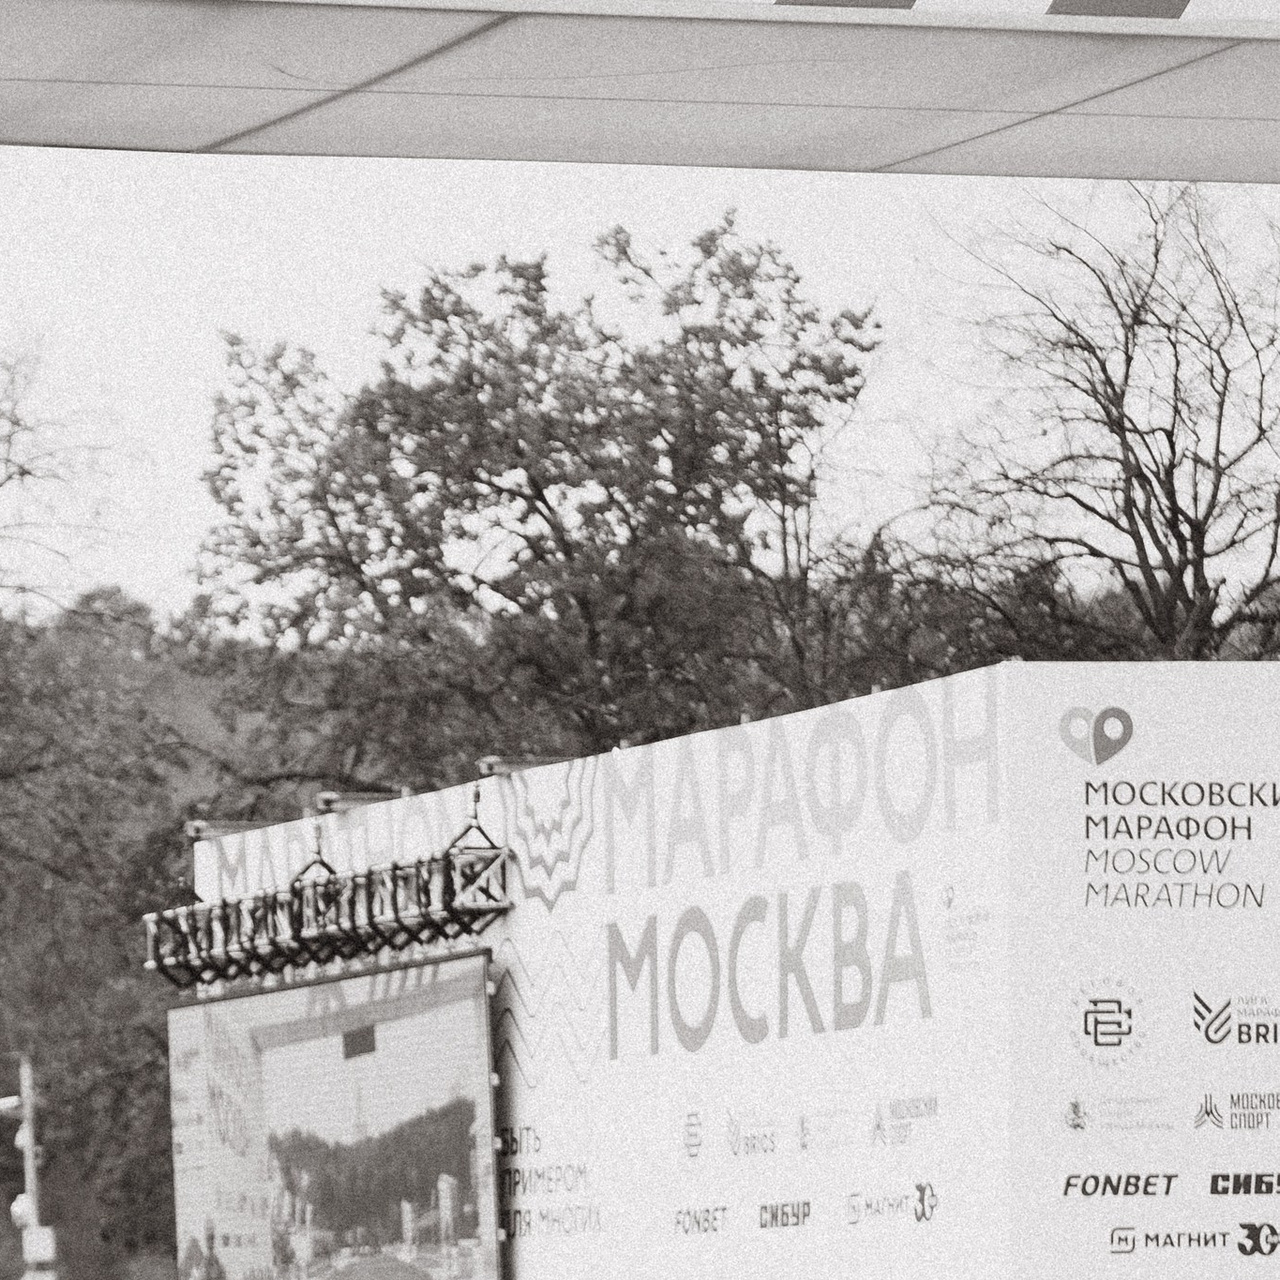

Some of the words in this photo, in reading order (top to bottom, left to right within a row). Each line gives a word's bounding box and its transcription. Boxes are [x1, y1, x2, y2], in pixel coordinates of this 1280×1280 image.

[601, 667, 1000, 895] МАРАФОН
[1085, 814, 1253, 841] МАРАФОН
[1084, 848, 1232, 875] MOSCOW
[1084, 882, 1265, 909] MARATHON
[606, 869, 933, 1061] МОСКВА
[1230, 1112, 1271, 1130] СПОРТ
[1063, 1174, 1179, 1196] FONBET
[759, 1200, 811, 1229] СИБУР
[1144, 1232, 1231, 1248] МАГНИТ
